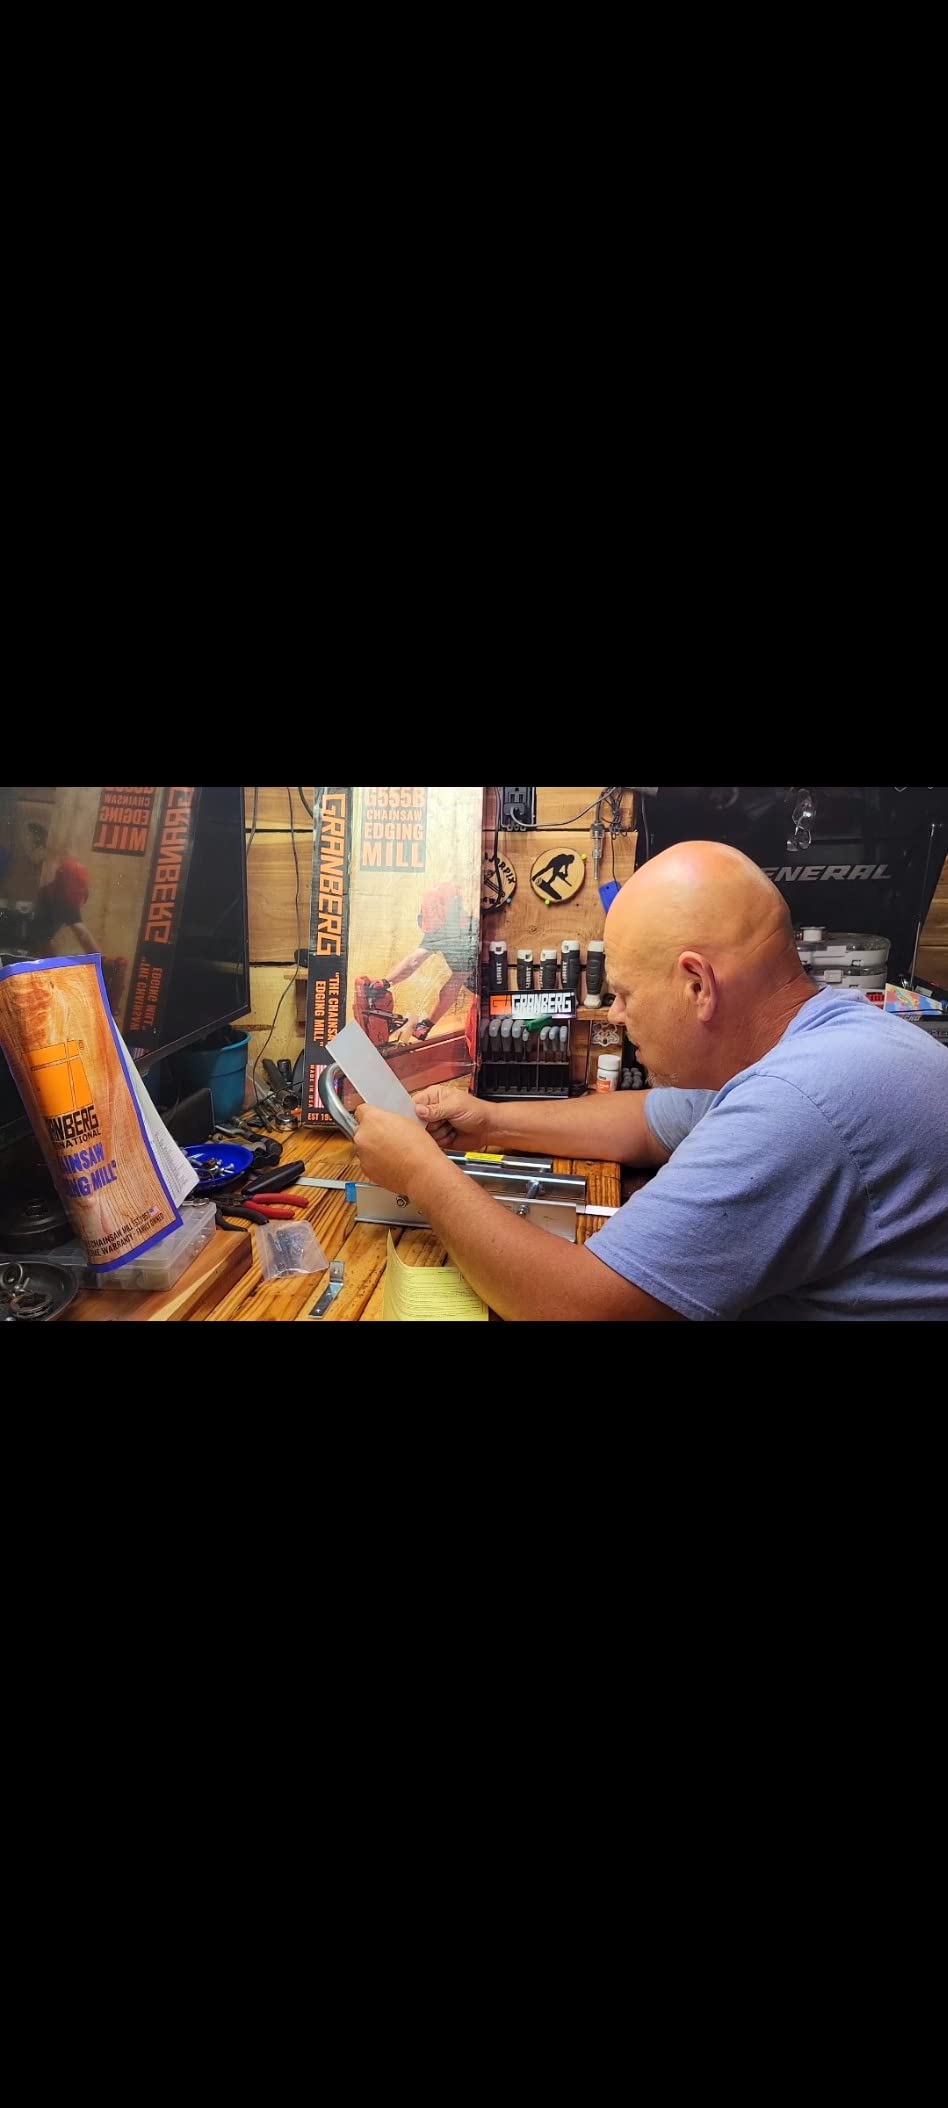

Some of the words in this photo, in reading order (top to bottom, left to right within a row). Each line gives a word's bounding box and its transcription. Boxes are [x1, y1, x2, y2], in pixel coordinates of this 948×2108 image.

[366, 809, 422, 821] CHAINSAW
[364, 822, 424, 840] EDGING
[362, 841, 424, 868] MILL
[317, 793, 346, 956] GRANBERG
[761, 864, 892, 882] ENERAL
[315, 981, 326, 1016] EDGING
[511, 993, 572, 1014] GRANBERG
[102, 1233, 133, 1255] WARRANTY
